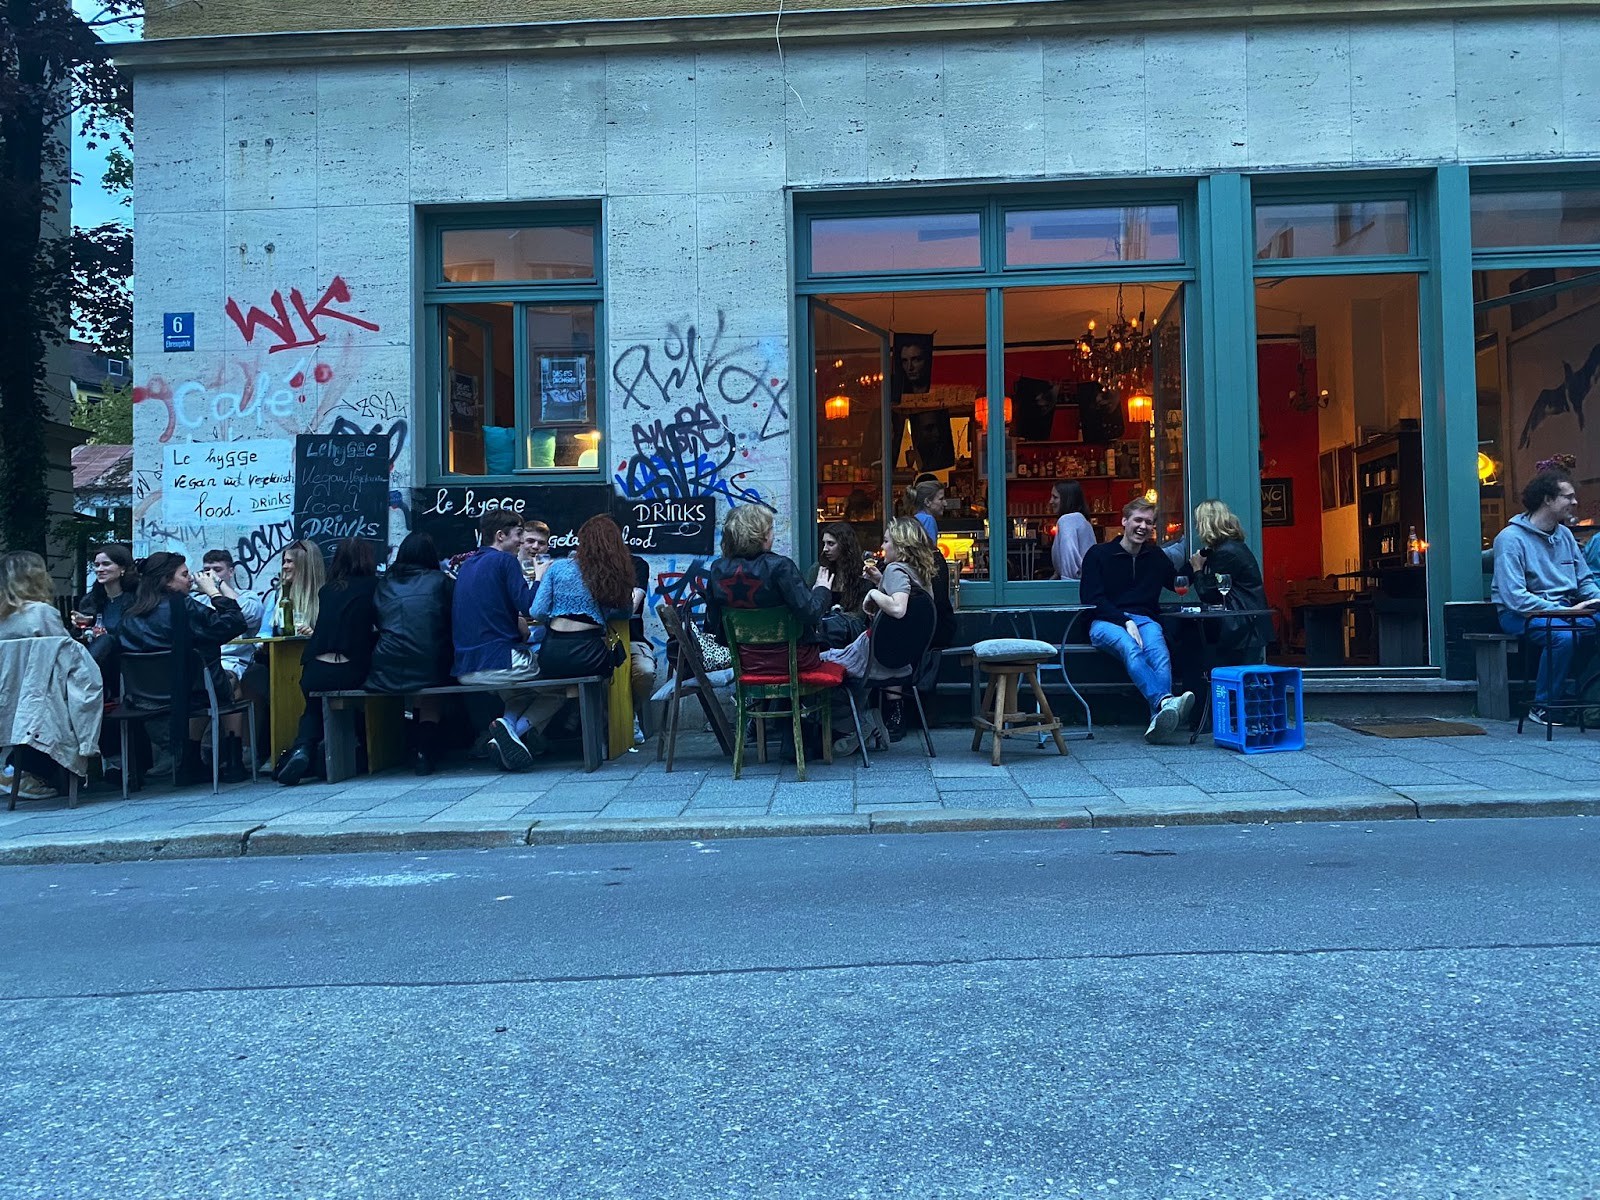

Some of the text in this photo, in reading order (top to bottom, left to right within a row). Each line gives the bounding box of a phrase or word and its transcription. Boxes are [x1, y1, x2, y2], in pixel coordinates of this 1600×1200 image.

[172, 316, 183, 333] 6
[173, 449, 190, 466] Le
[1260, 486, 1281, 501] WC
